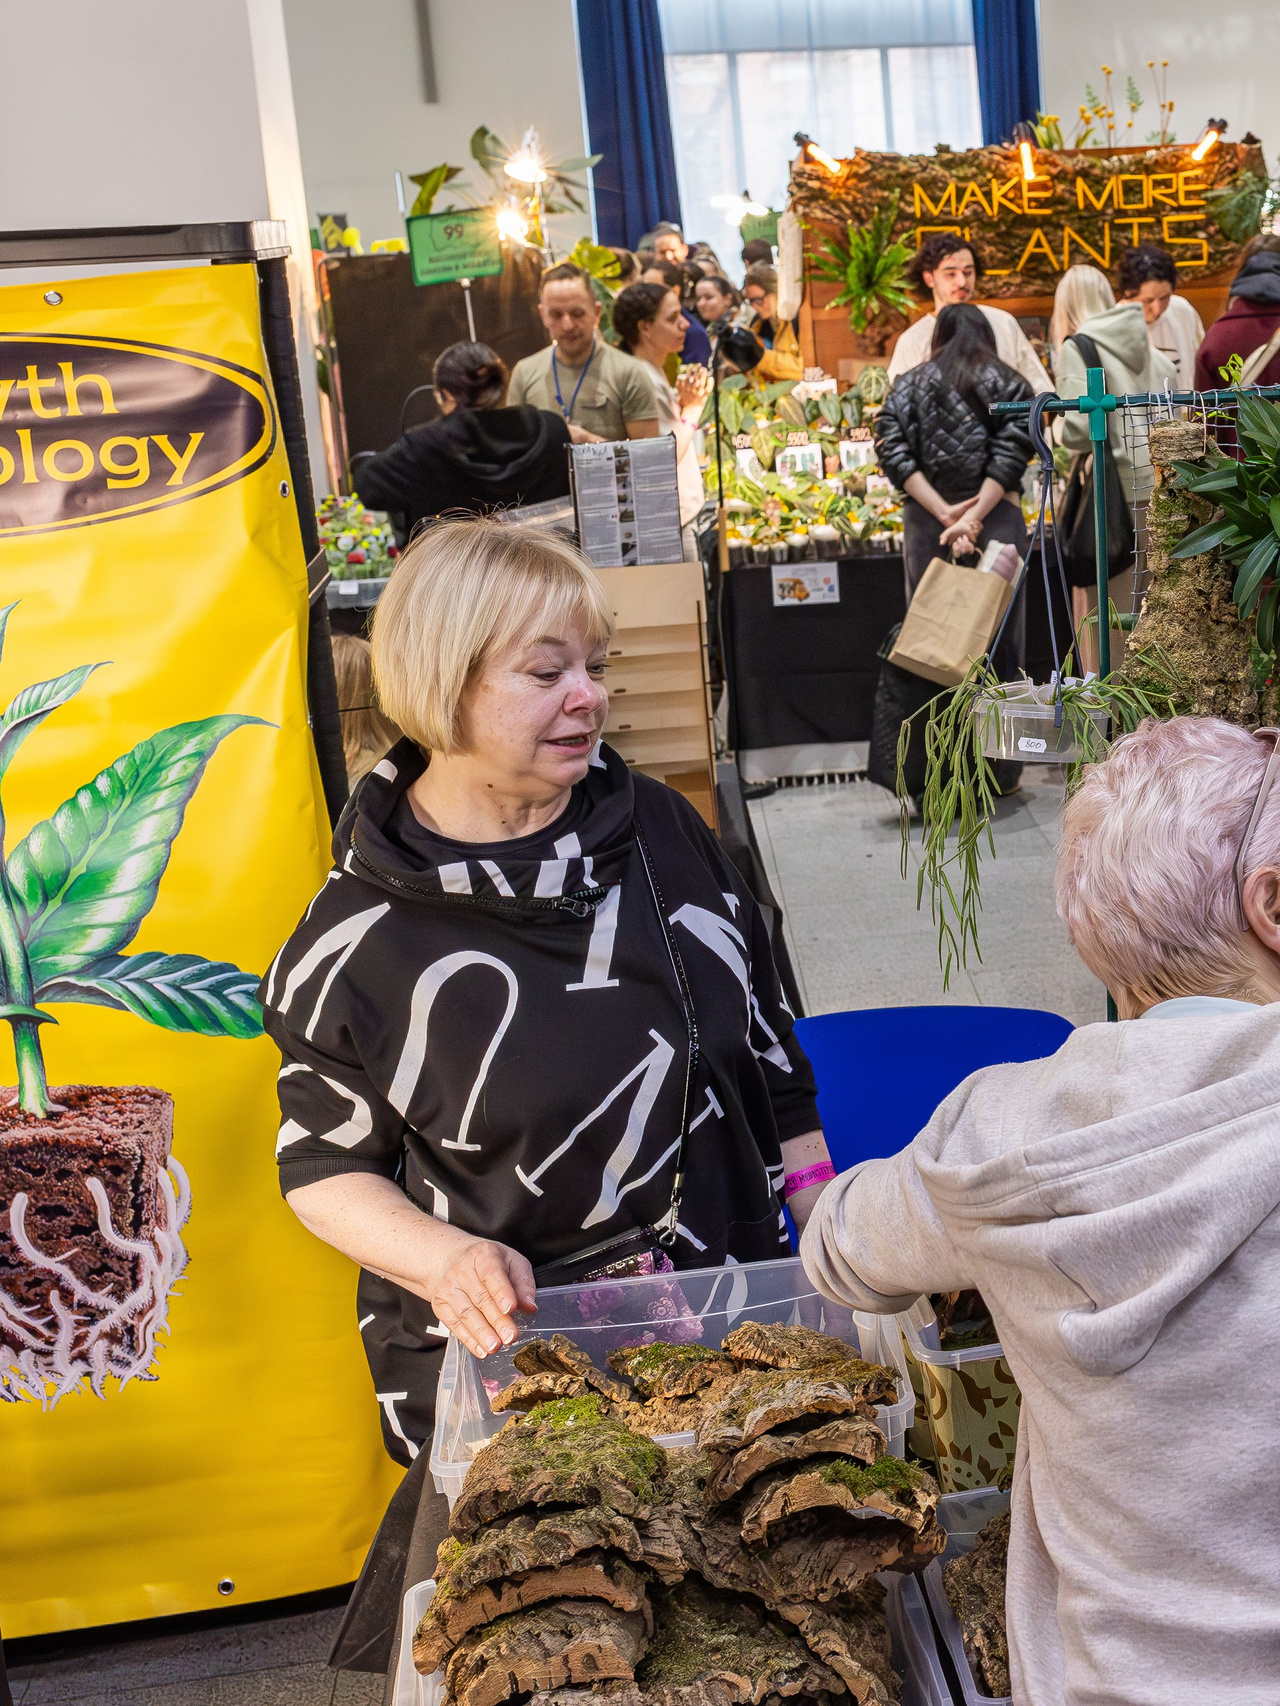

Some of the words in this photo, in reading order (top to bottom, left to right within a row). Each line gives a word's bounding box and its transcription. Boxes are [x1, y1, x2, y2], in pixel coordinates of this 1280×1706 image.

[913, 174, 1053, 218] MAKE
[1075, 168, 1210, 210] MORE
[443, 223, 464, 241] 99
